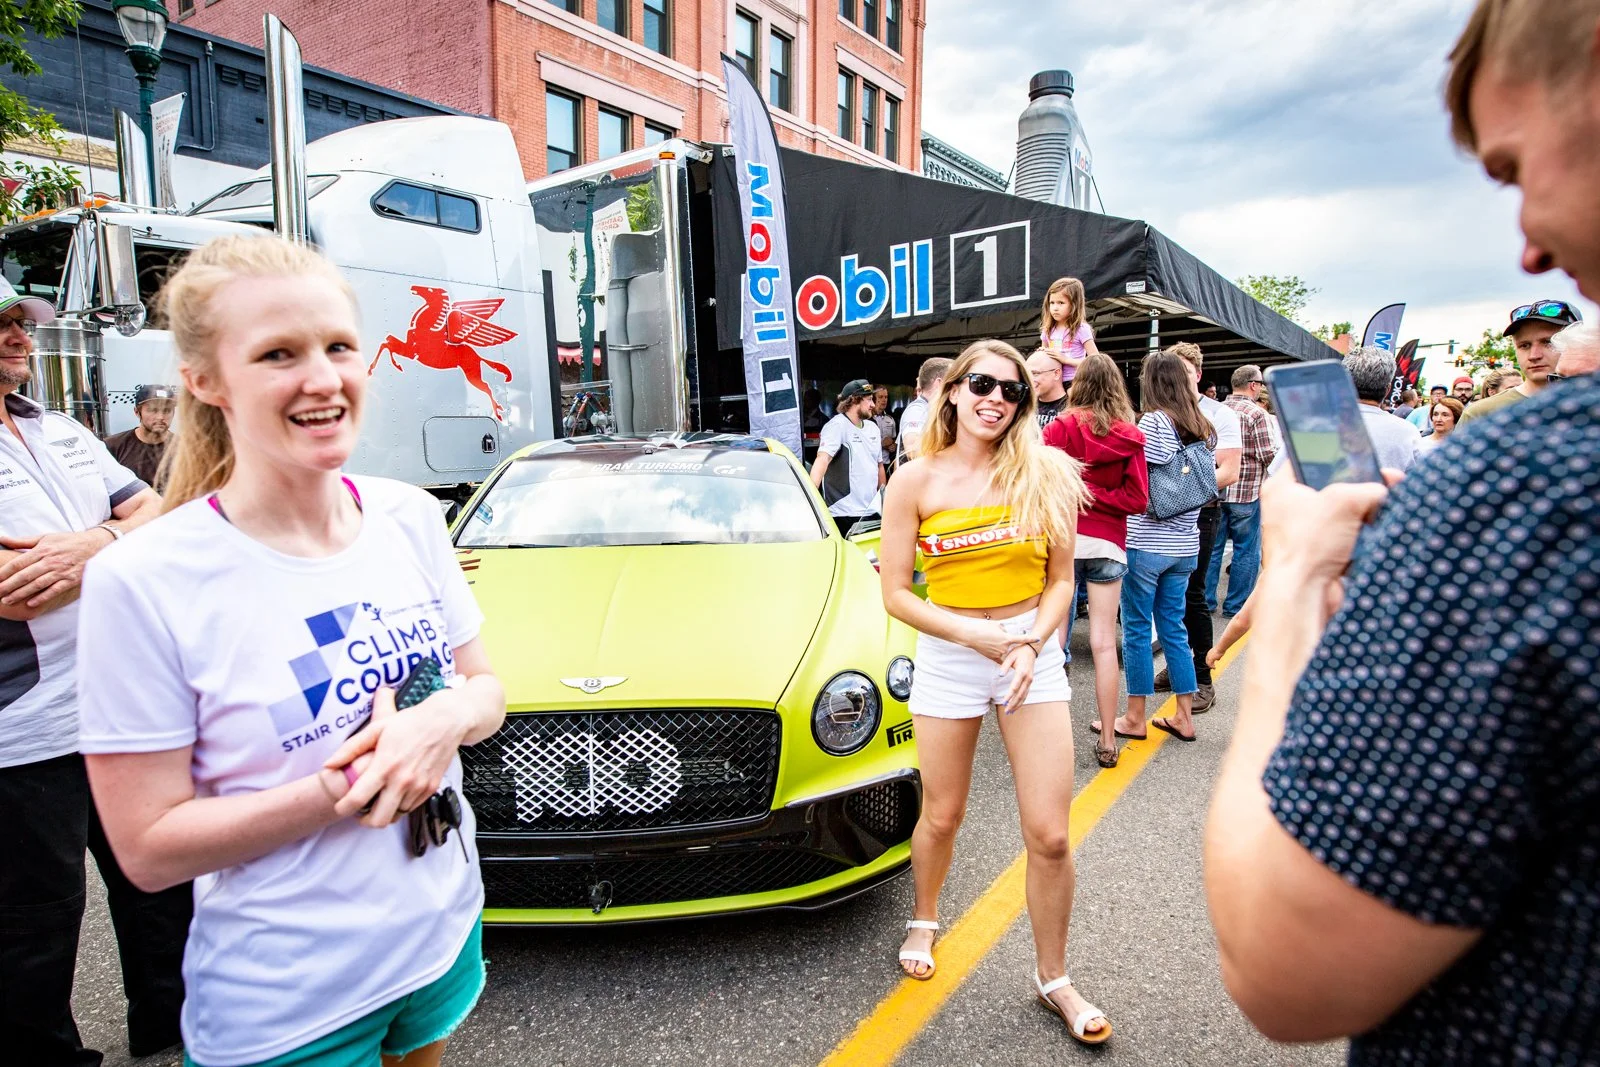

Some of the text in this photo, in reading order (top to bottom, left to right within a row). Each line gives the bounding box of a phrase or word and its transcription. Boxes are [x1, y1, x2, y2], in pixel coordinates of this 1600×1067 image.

[747, 159, 788, 345] Mobil
[740, 238, 934, 340] obil
[637, 462, 704, 472] TURISMO
[0, 479, 30, 490] RINCESS
[941, 525, 1020, 551] SNOOPY
[347, 618, 437, 665] CLIMB
[335, 641, 453, 705] COURAG
[281, 724, 332, 753] STAIR
[886, 718, 914, 748] PIR
